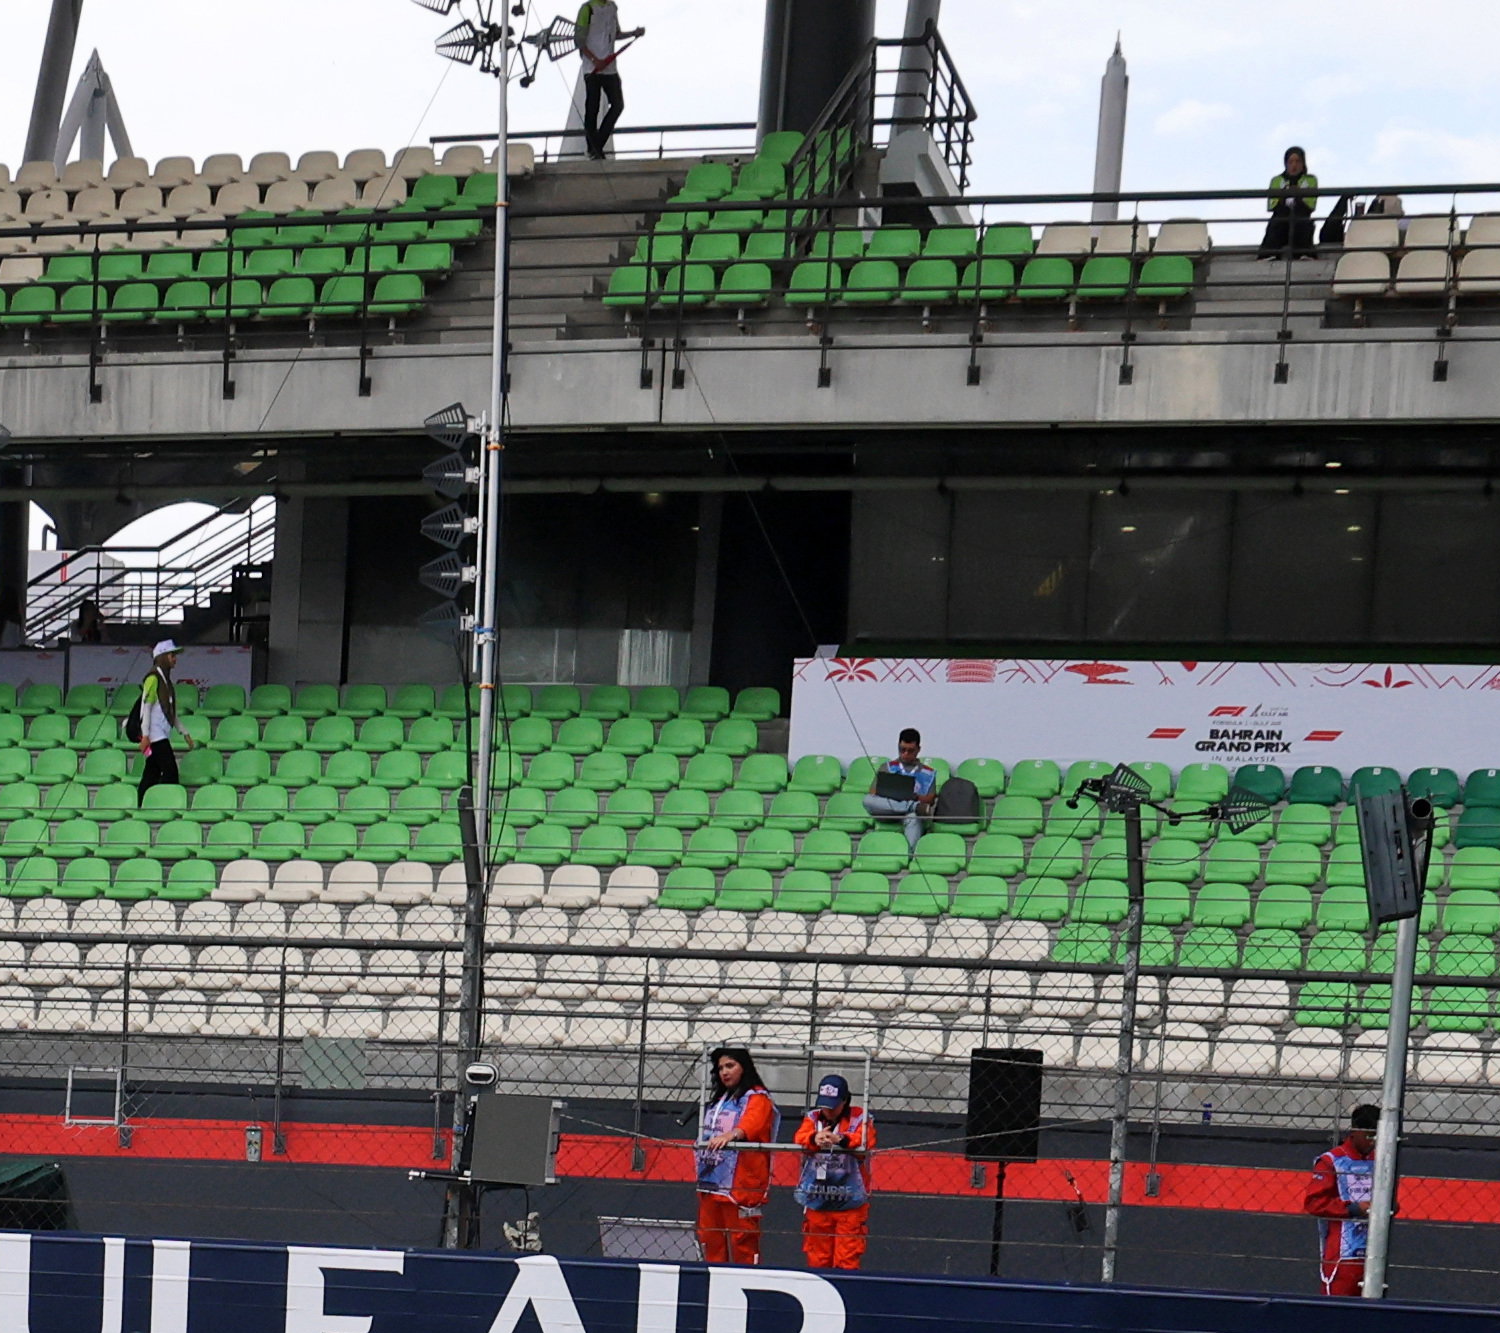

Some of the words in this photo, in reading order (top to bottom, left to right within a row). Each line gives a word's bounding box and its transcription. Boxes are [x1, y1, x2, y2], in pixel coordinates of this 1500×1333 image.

[1209, 728, 1283, 740] BAHRAIN
[1195, 740, 1251, 752] GRAND
[1254, 742, 1292, 753] PRIX
